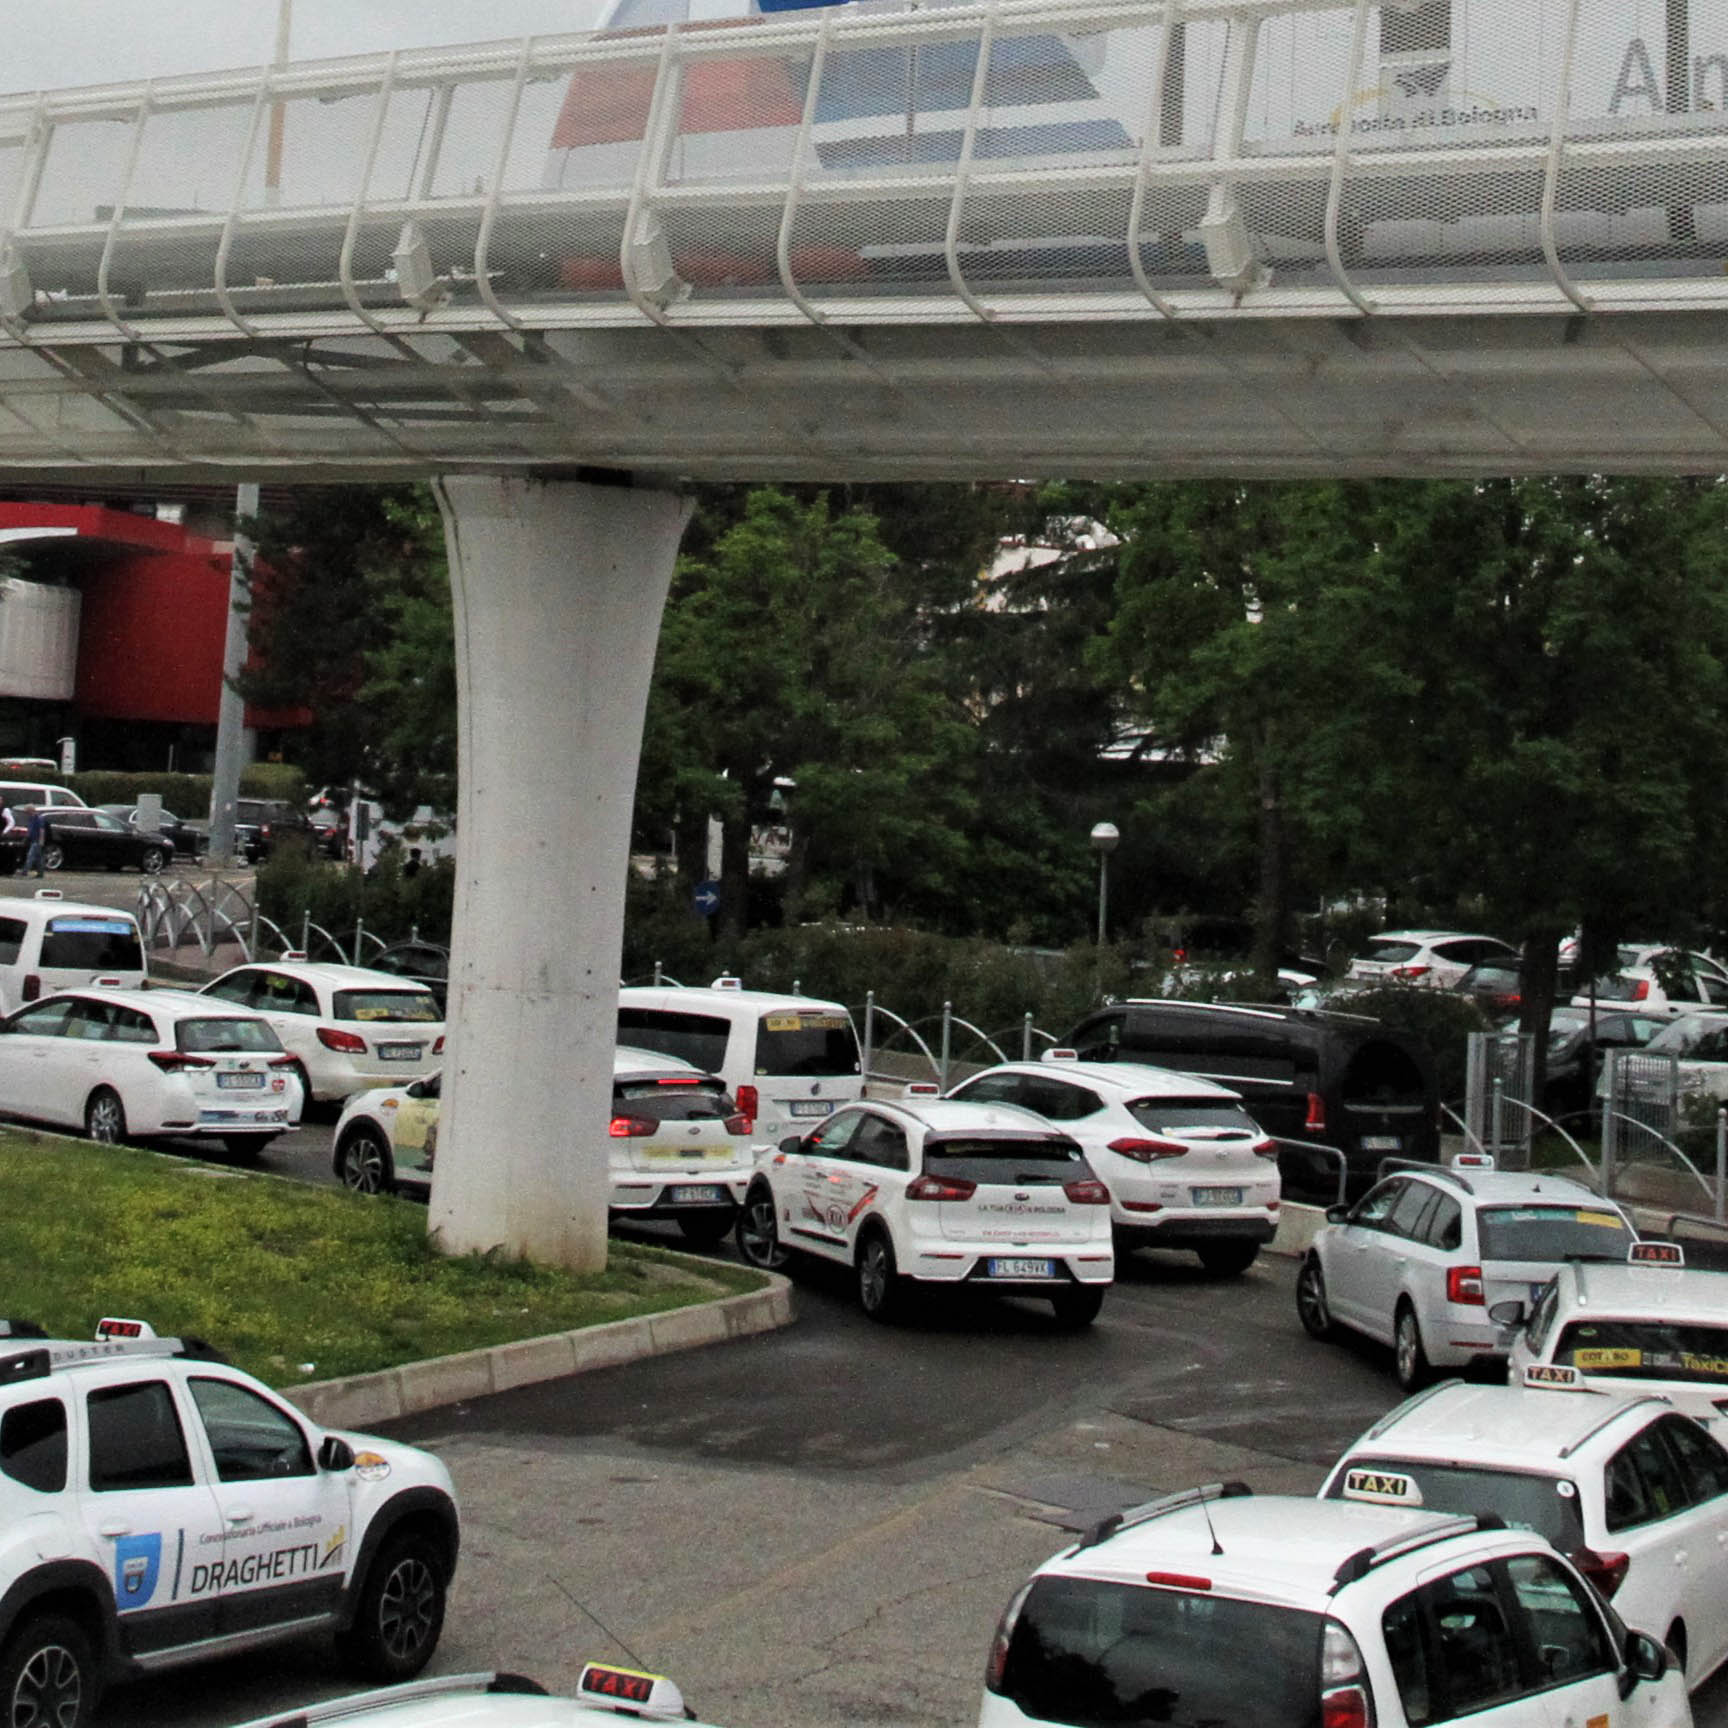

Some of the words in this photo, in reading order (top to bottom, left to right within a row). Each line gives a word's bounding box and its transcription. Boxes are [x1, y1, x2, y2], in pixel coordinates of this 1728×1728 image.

[1636, 1246, 1677, 1261] TAXI
[53, 1343, 125, 1361] DUSTER
[1530, 1367, 1573, 1383] TAXI
[1351, 1473, 1405, 1496] TAXI
[191, 1543, 319, 1595] DRAGHETTI
[587, 1669, 651, 1702] TAXI
